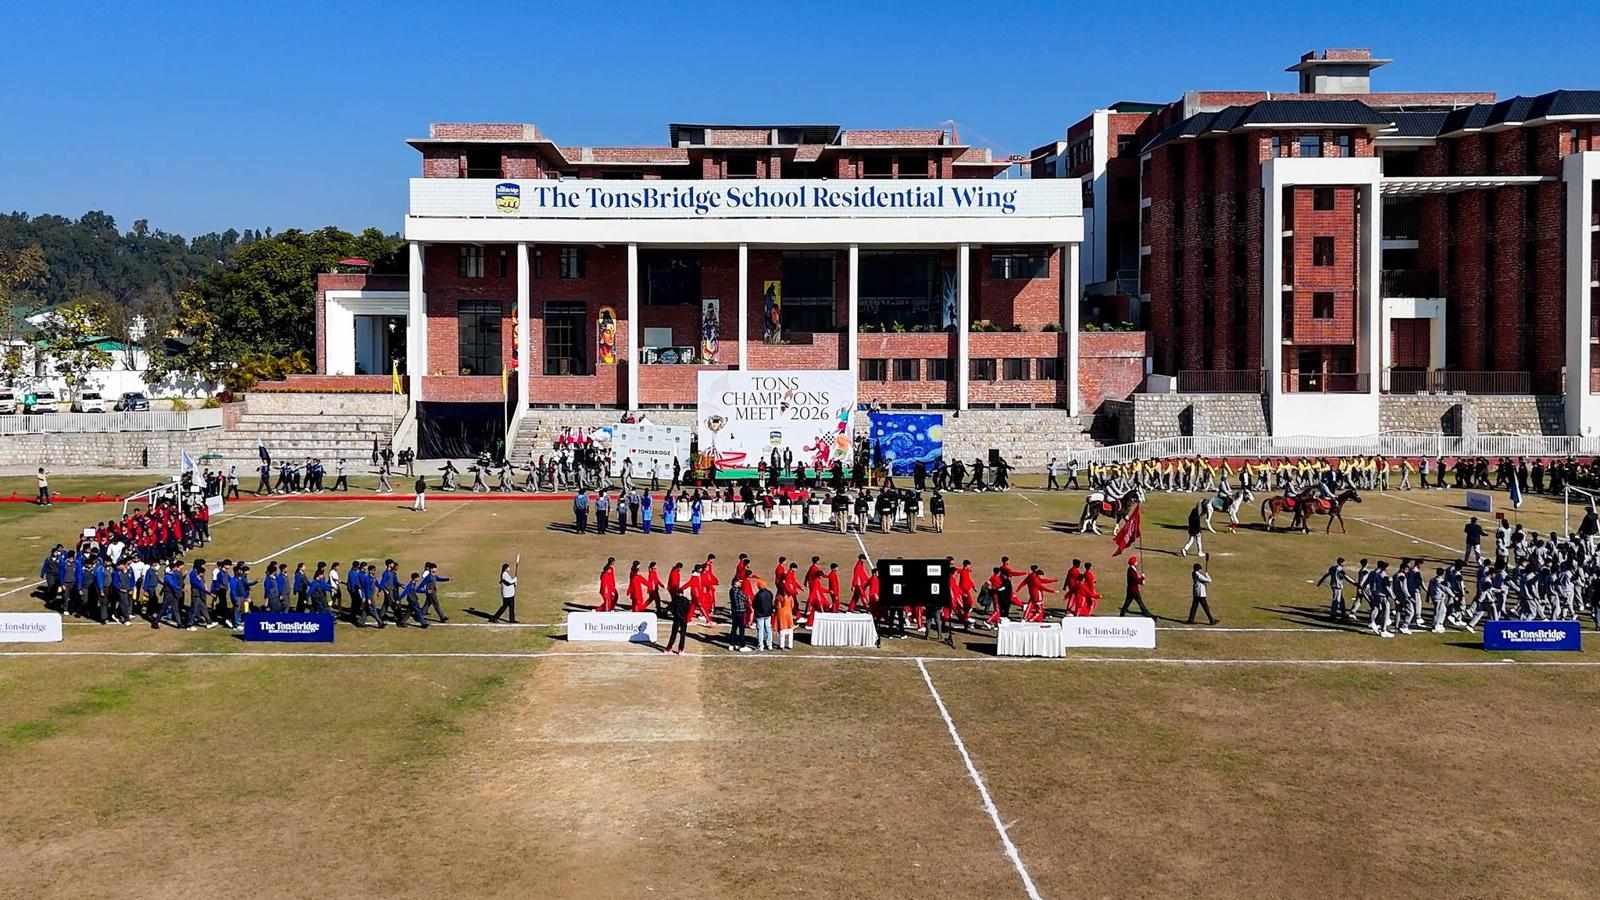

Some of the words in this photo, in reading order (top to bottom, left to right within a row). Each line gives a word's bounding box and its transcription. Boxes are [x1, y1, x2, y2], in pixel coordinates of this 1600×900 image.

[534, 186, 580, 208] The
[586, 186, 721, 215] TonsBridge
[726, 185, 806, 208] School
[813, 185, 944, 208] Residential
[952, 186, 1017, 215] Wing
[752, 377, 799, 391] TONS
[722, 391, 830, 406] CHAMPONS
[735, 407, 779, 421] MEET
[790, 406, 830, 421] 2026
[259, 621, 275, 631] The
[276, 621, 320, 633] TonsBridge
[584, 623, 599, 631] The
[600, 623, 639, 633] TonsBridg
[1078, 627, 1093, 635] The
[1095, 627, 1139, 637] TonsBridge
[1501, 630, 1518, 639] The
[1518, 629, 1566, 641] TonsBridge
